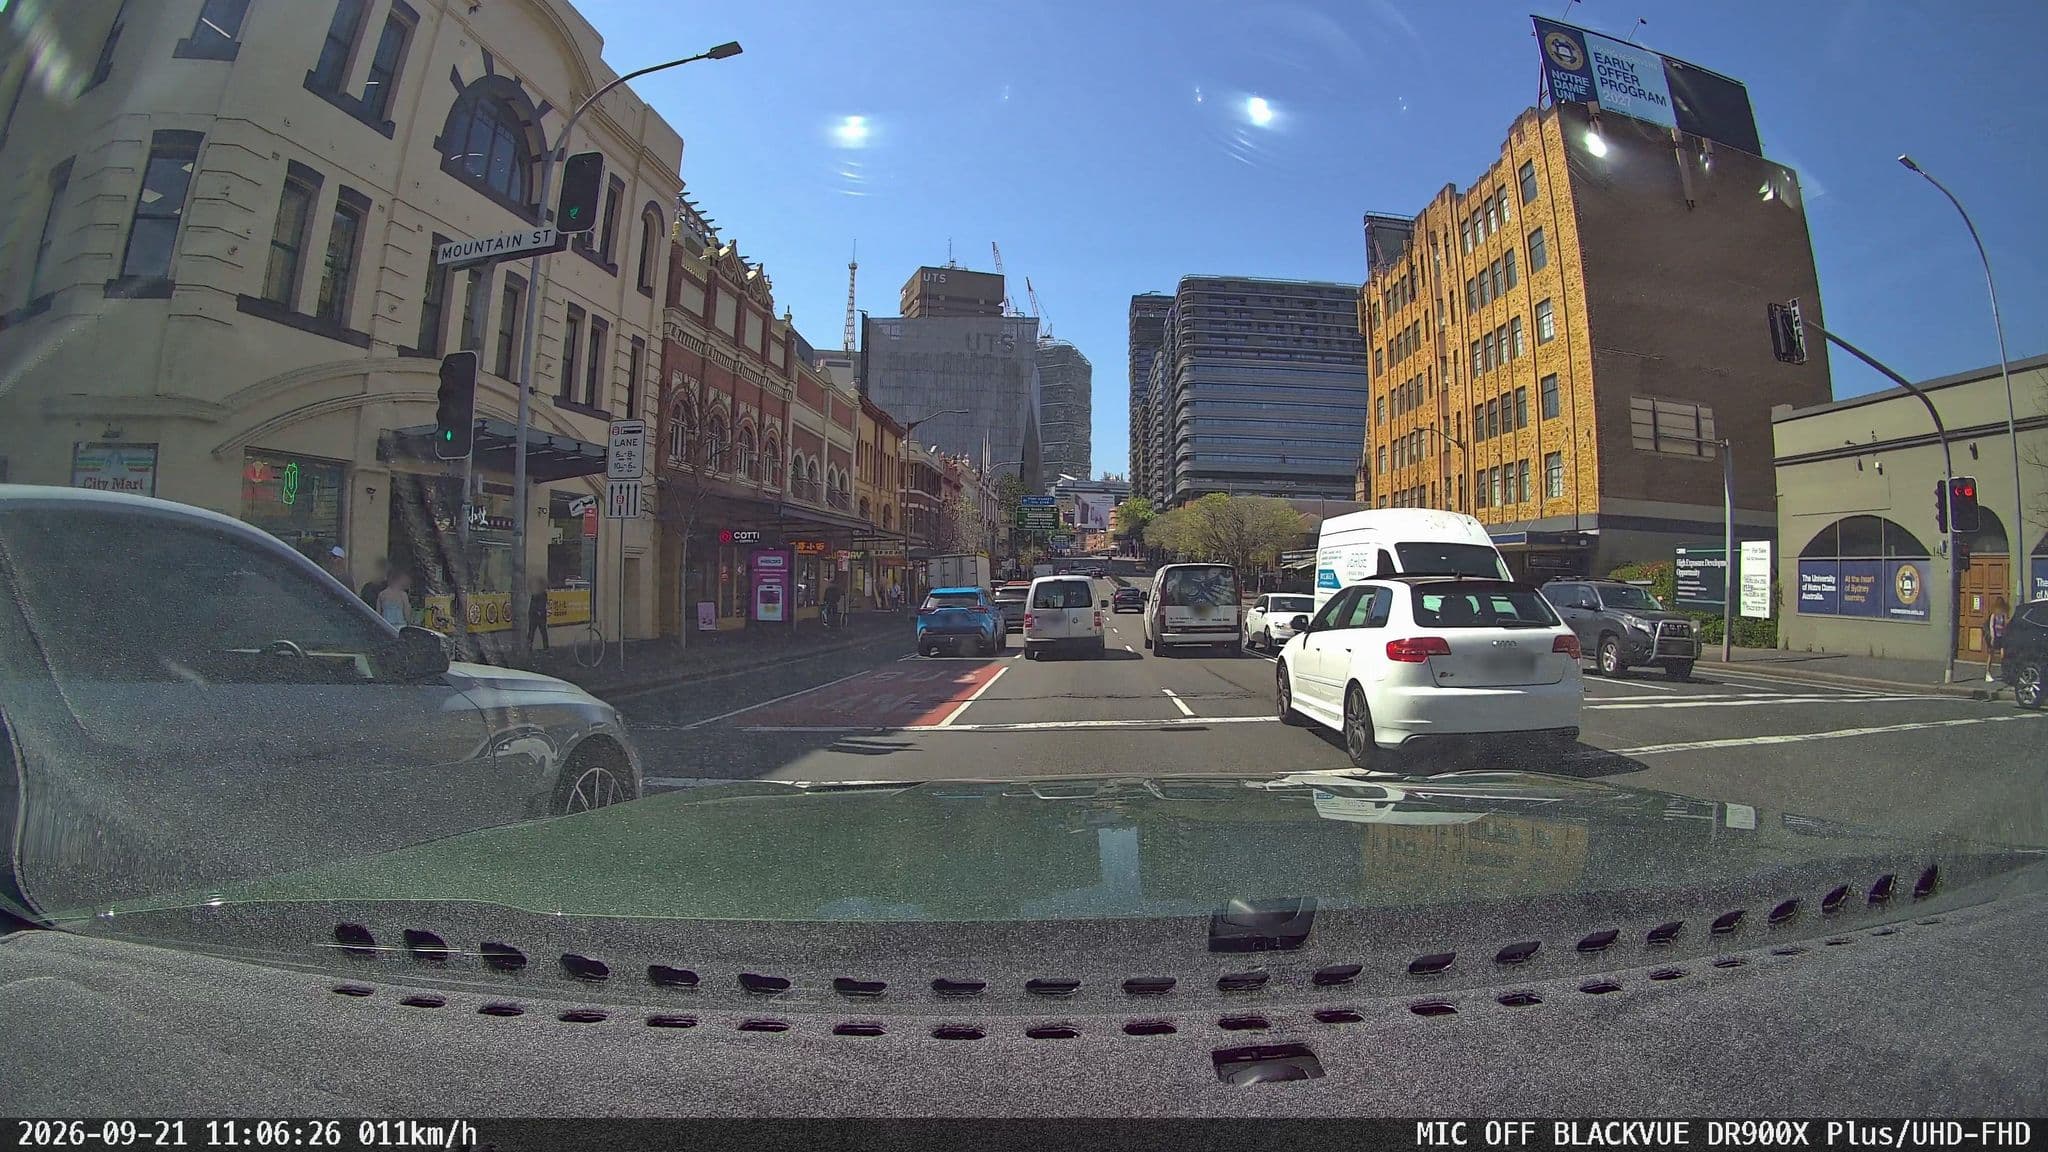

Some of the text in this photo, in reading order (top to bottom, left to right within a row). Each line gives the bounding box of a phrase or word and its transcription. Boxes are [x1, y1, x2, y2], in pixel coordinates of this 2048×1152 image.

[1593, 52, 1635, 73] EARLY
[1551, 69, 1590, 86] NOTRE
[1597, 65, 1641, 86] OFFER
[1553, 79, 1587, 96] DAME
[1600, 77, 1667, 107] PROGRAM
[1555, 88, 1576, 102] UNI
[441, 229, 551, 260] MOUNTAIN ST
[923, 272, 947, 283] UTS
[614, 438, 638, 447] LANE
[83, 477, 144, 490] City Mart
[733, 531, 760, 539] COTTI
[1802, 574, 1836, 584] The University
[2035, 577, 2048, 587] The
[1802, 583, 1808, 591] of
[1808, 583, 1821, 591] Notre
[2036, 590, 2043, 599] of
